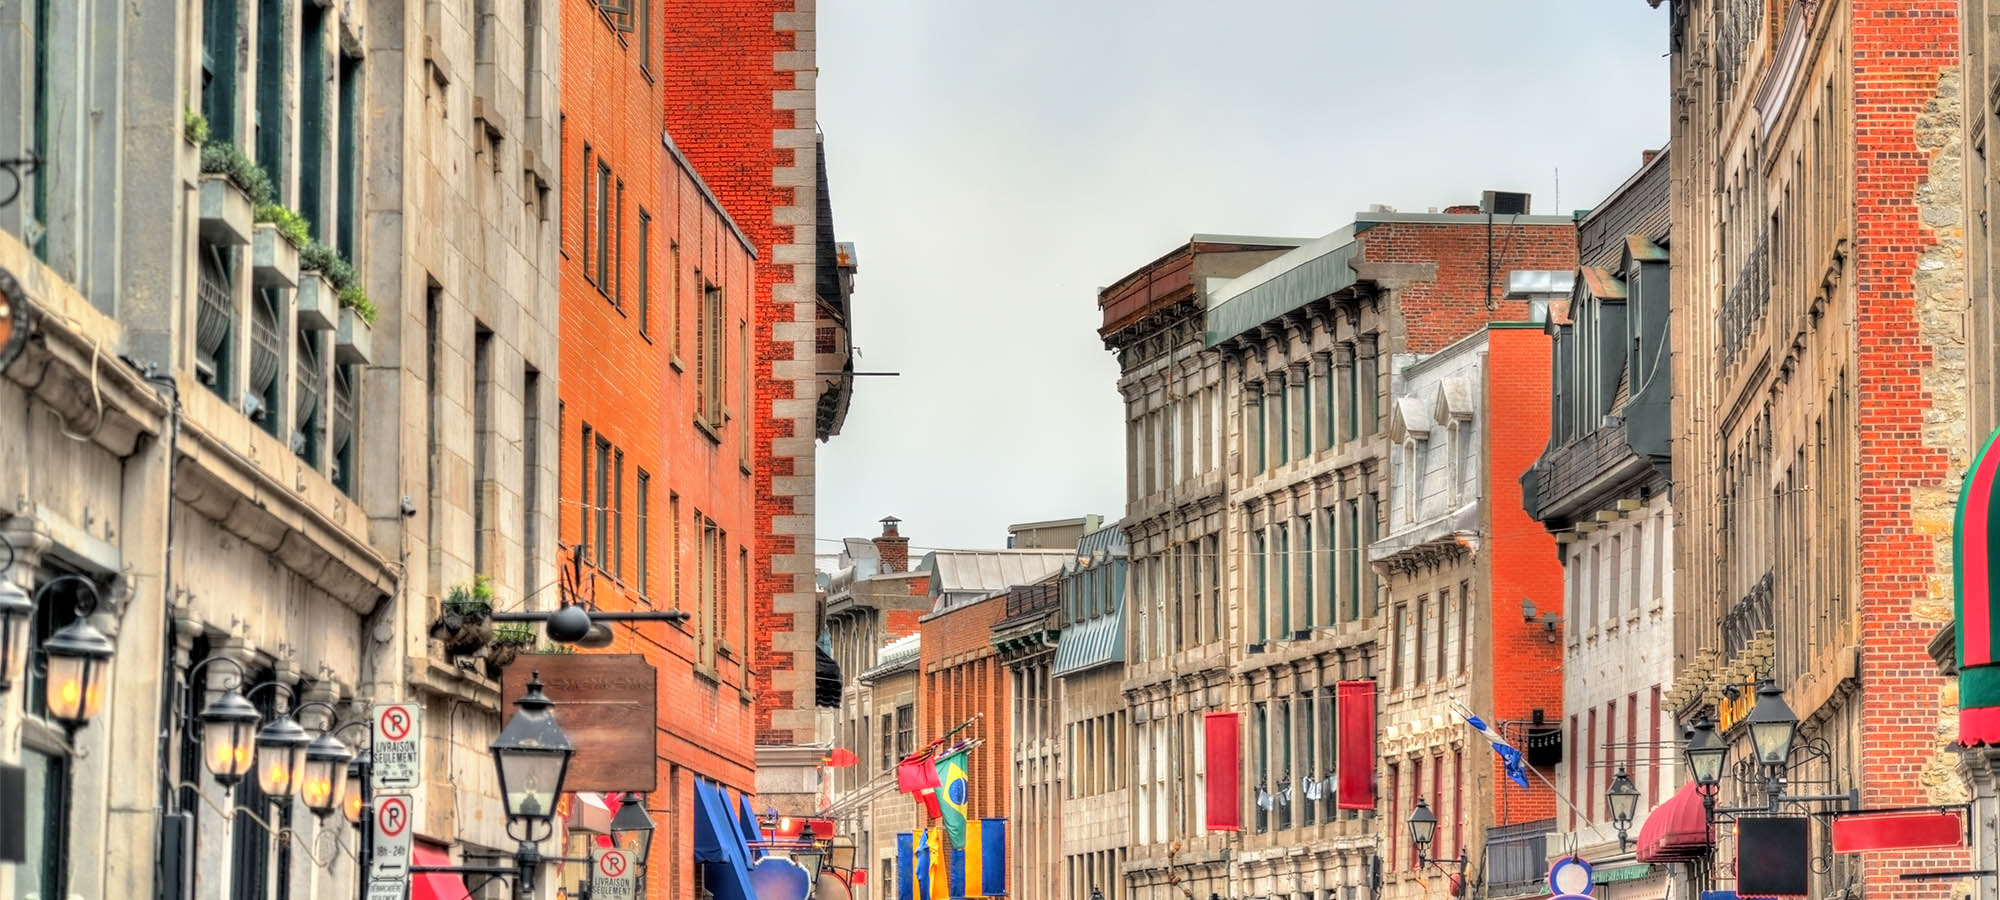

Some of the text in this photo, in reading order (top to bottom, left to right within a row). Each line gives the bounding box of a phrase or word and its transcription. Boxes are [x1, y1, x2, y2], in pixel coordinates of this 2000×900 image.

[376, 741, 415, 753] LIVRAISON
[373, 752, 417, 764] SEULEMENT
[594, 877, 630, 887] LIVRAISON
[592, 885, 631, 896] SEULEMENT
